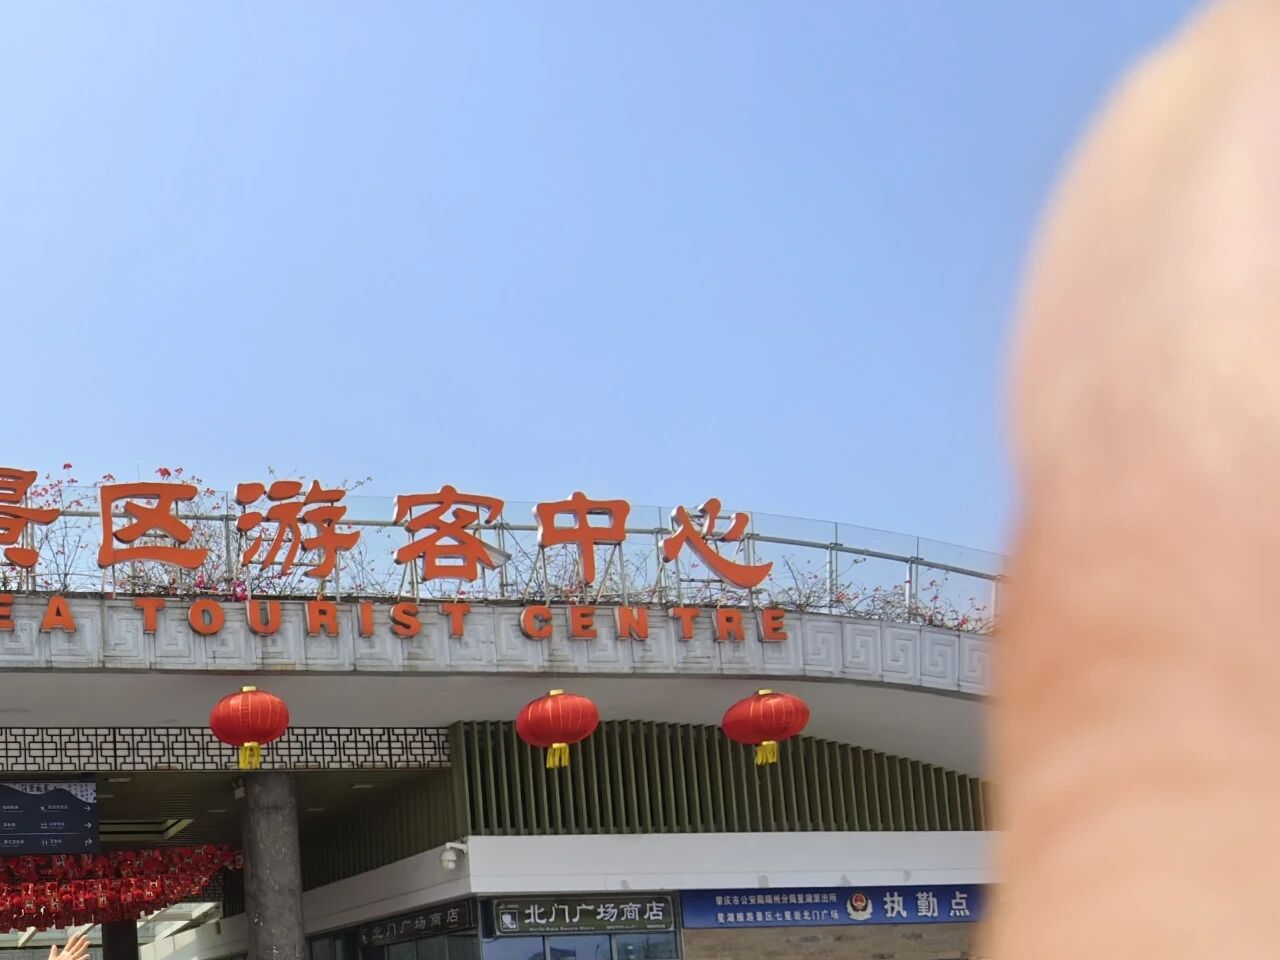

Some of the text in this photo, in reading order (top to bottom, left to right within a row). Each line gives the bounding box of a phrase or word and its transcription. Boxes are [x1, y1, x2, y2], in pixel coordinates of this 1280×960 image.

[132, 598, 470, 638] TOURIST
[520, 605, 789, 643] CENTRE
[524, 901, 665, 924] 北门广场商店
[884, 890, 971, 918] 执勤点
[372, 908, 459, 939] 北门广场商店
